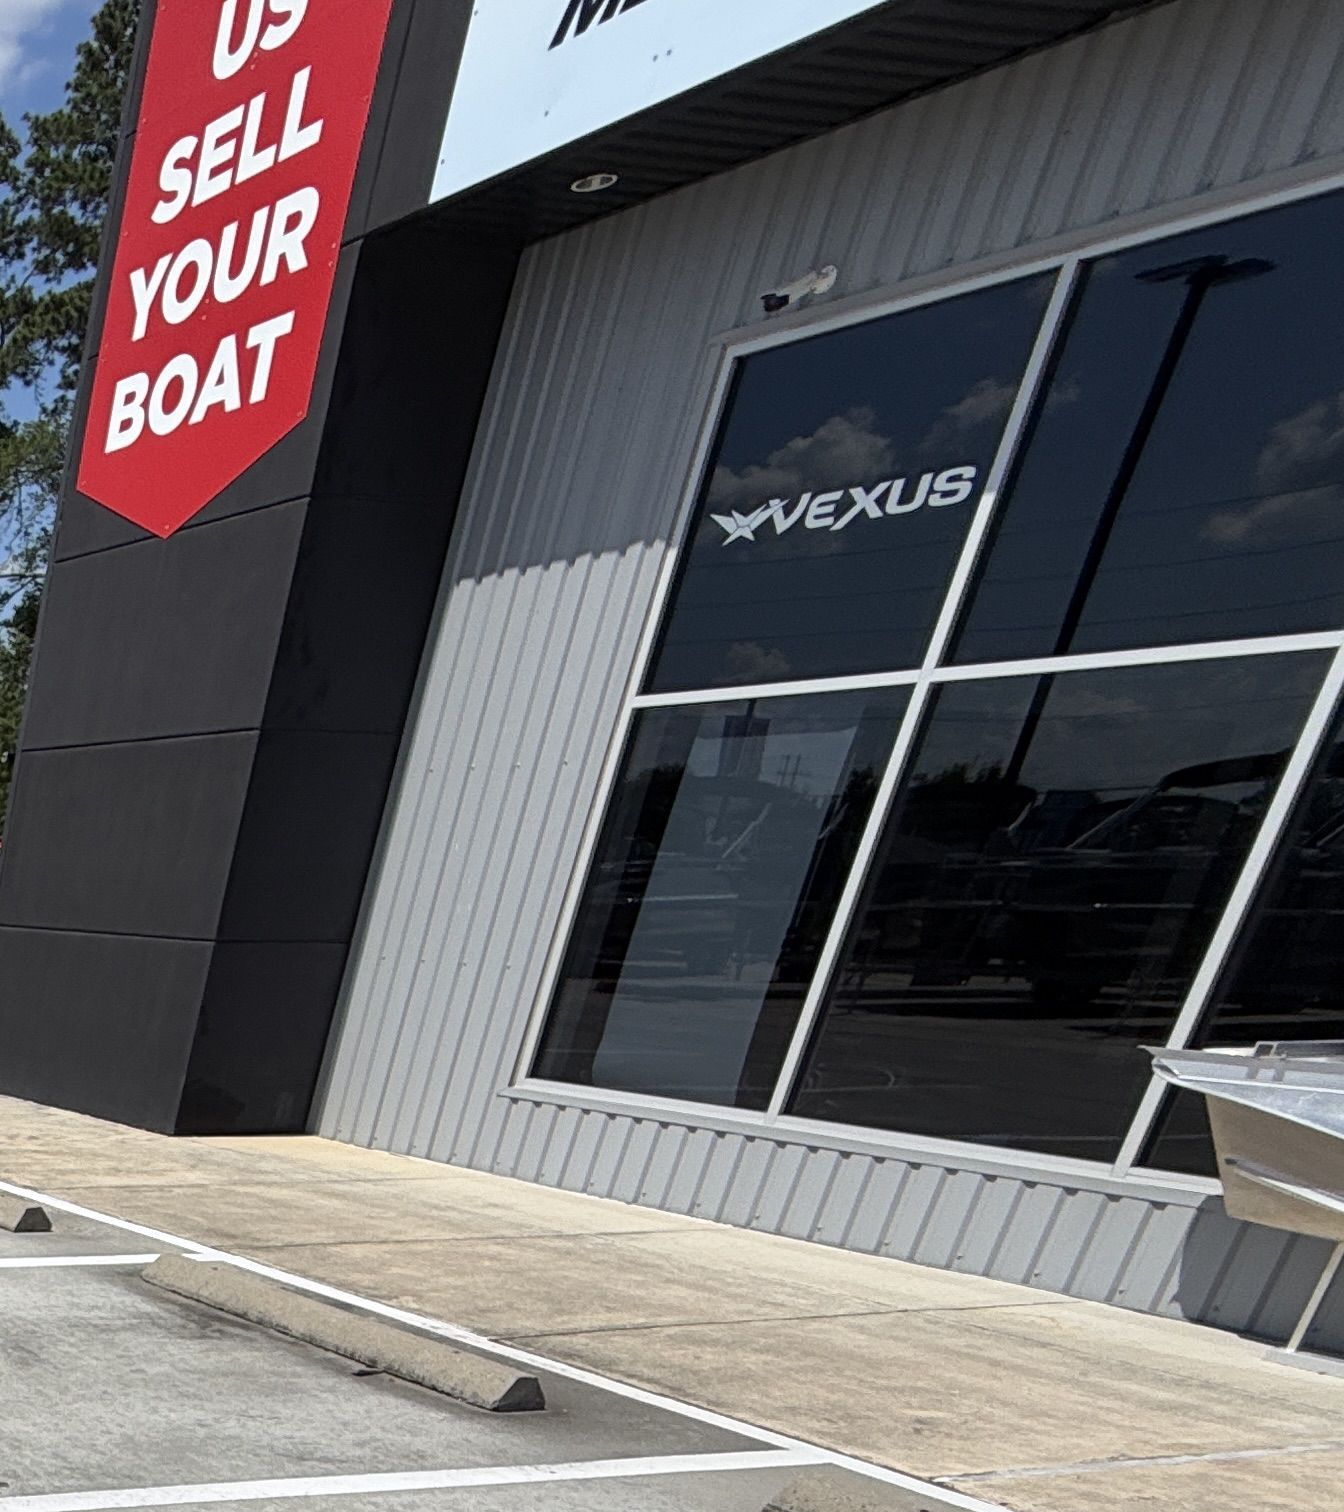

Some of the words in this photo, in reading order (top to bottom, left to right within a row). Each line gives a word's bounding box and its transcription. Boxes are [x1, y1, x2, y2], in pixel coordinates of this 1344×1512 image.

[151, 65, 323, 224] SELL
[129, 186, 320, 342] YOUR
[104, 310, 296, 454] BOAT
[768, 465, 977, 535] VEXUS
